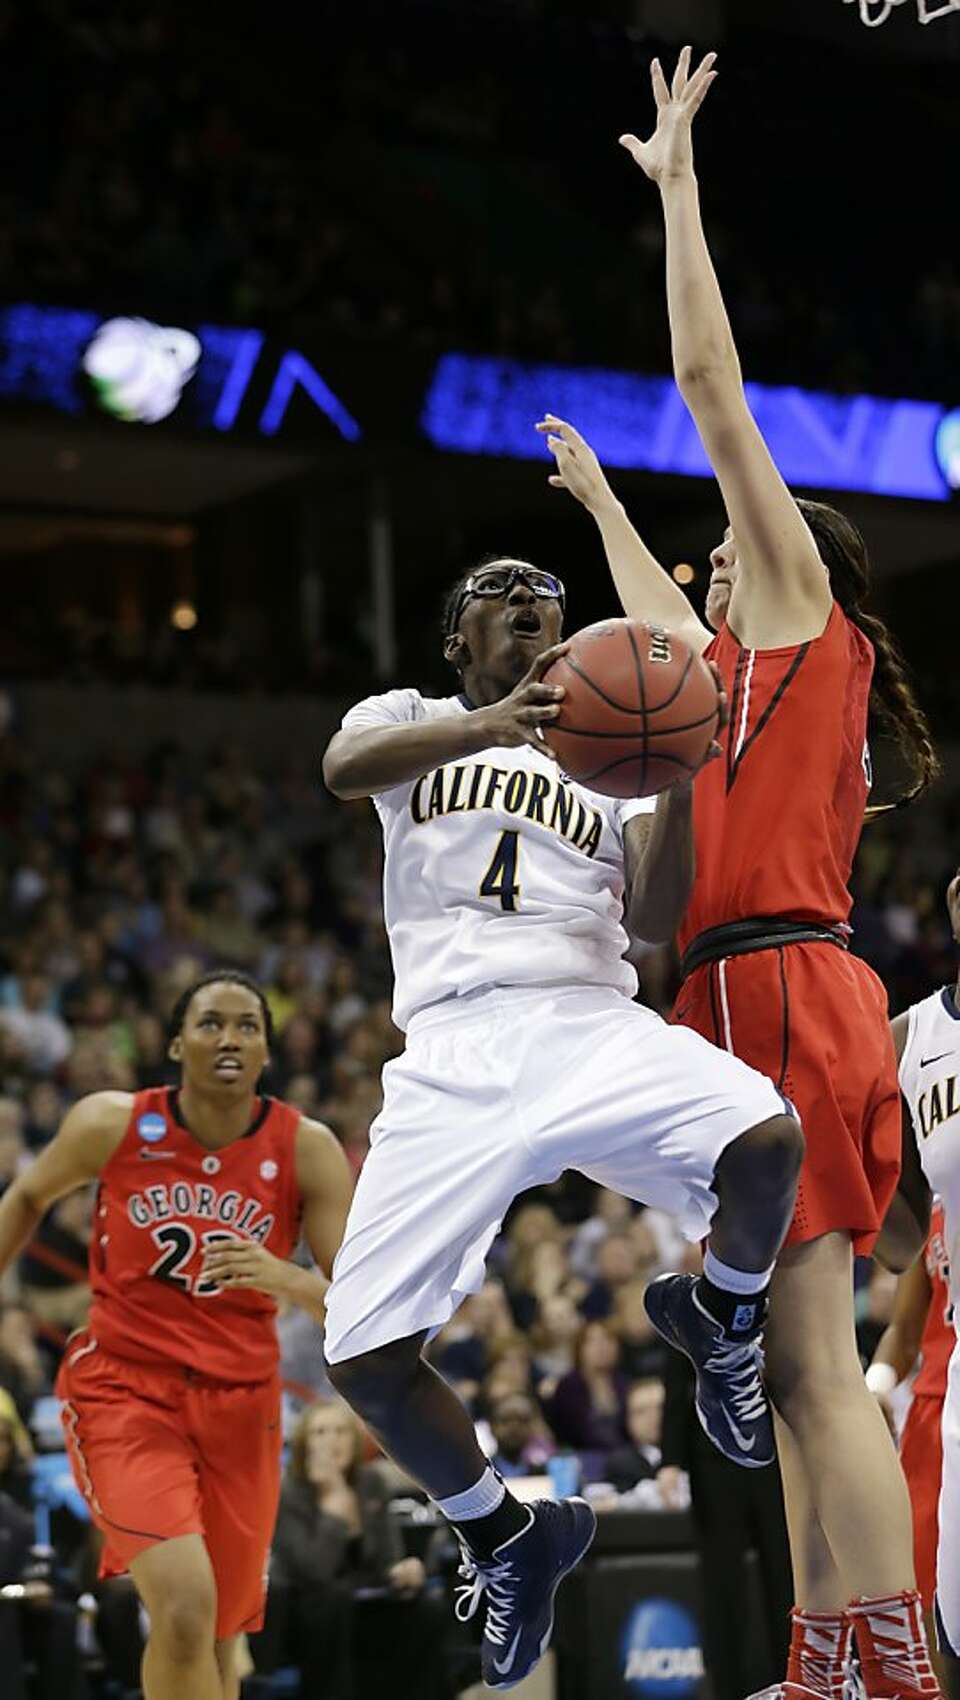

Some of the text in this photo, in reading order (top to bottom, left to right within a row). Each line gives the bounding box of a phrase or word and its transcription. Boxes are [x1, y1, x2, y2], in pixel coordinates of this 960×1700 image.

[410, 764, 603, 860] CALIFORNIA
[478, 829, 521, 913] 4
[128, 1180, 275, 1244] GEORGIA
